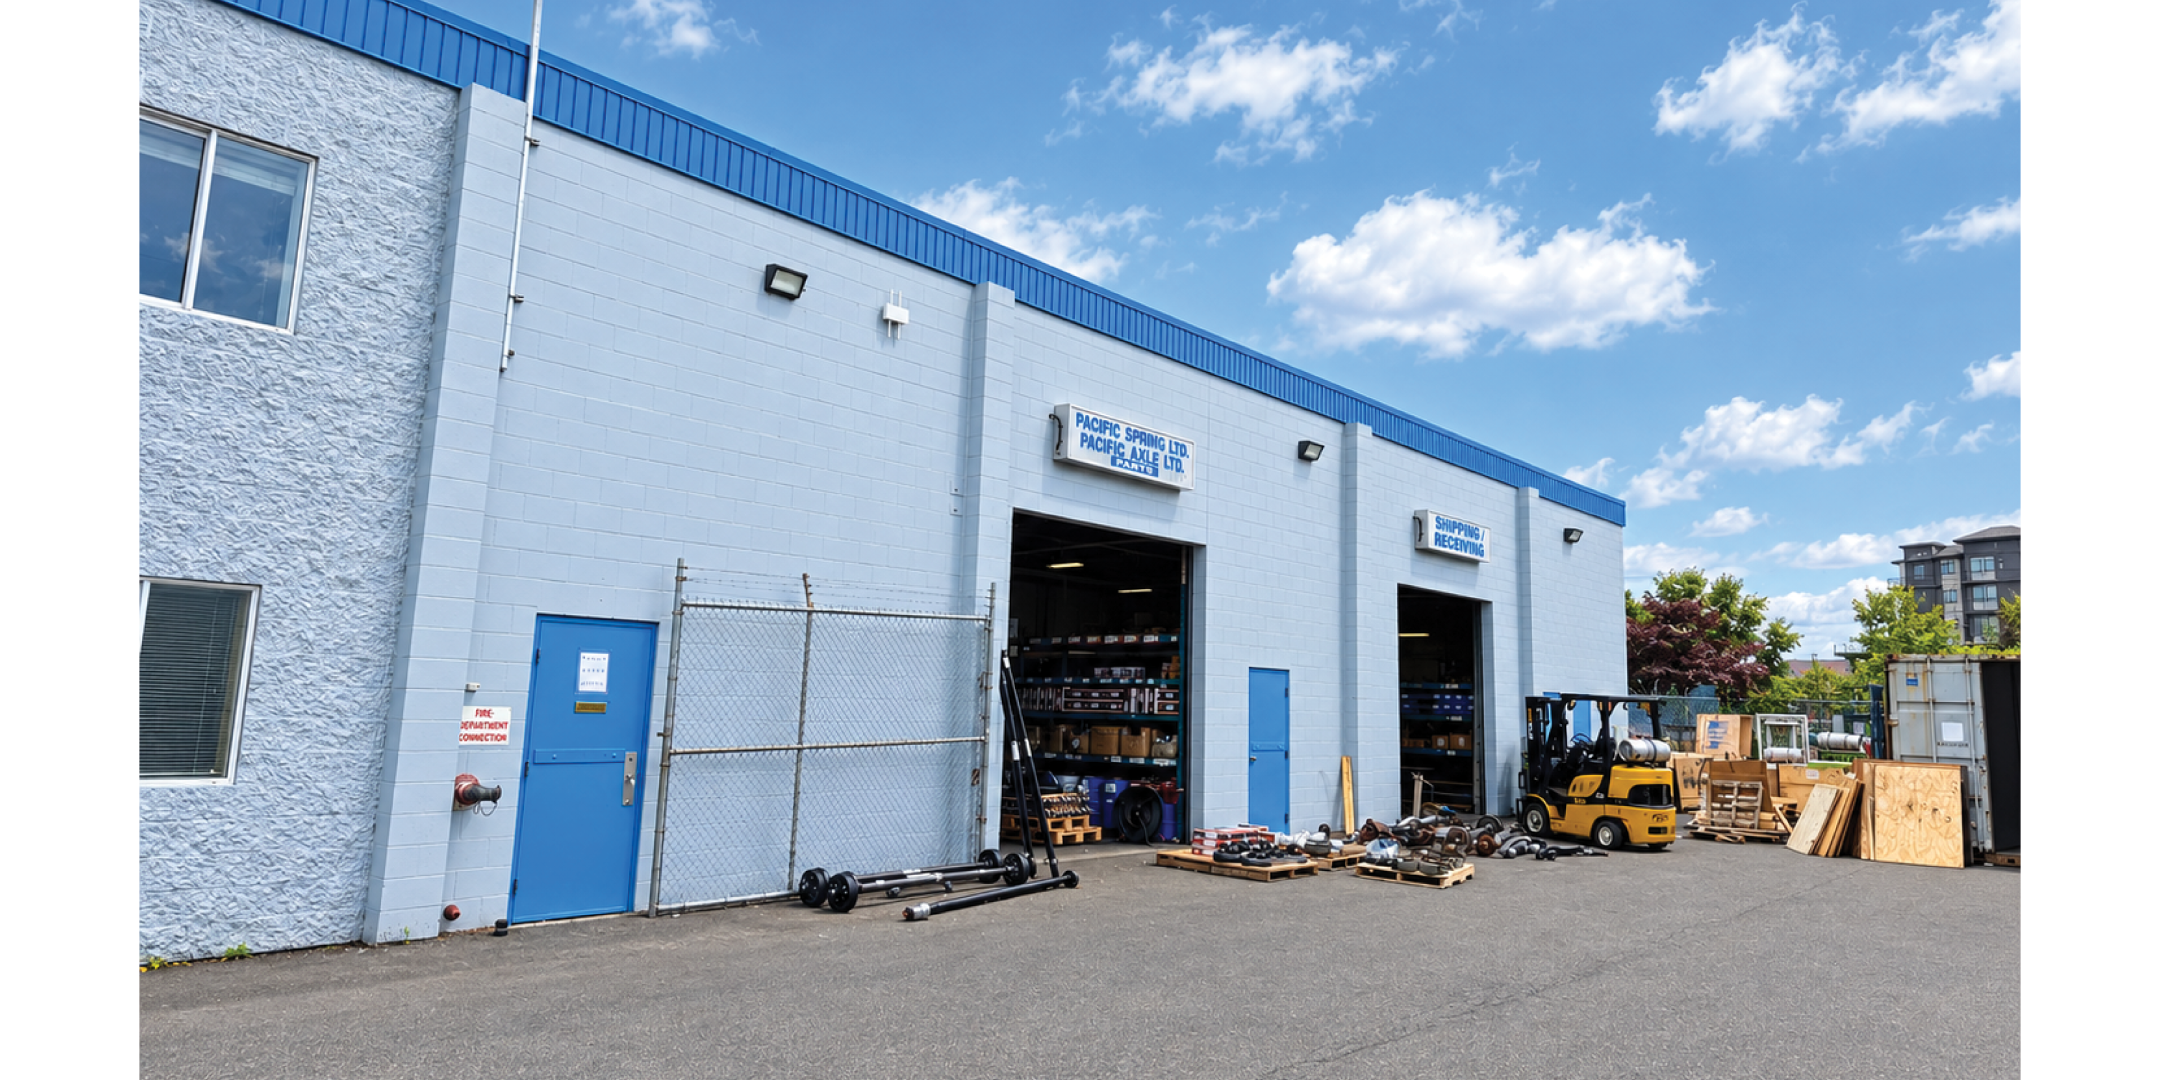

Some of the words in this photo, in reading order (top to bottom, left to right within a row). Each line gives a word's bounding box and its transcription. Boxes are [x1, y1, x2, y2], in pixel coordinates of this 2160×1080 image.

[1076, 412, 1121, 438] PACIFIC
[1125, 427, 1165, 451] SPRING
[1168, 439, 1190, 458] LTD.
[1080, 433, 1125, 457] PACIFIC
[1130, 446, 1159, 466] AXLE
[1164, 454, 1185, 473] LTD.
[1435, 532, 1484, 557] RECEIVING
[458, 733, 507, 742] CONNECTION
